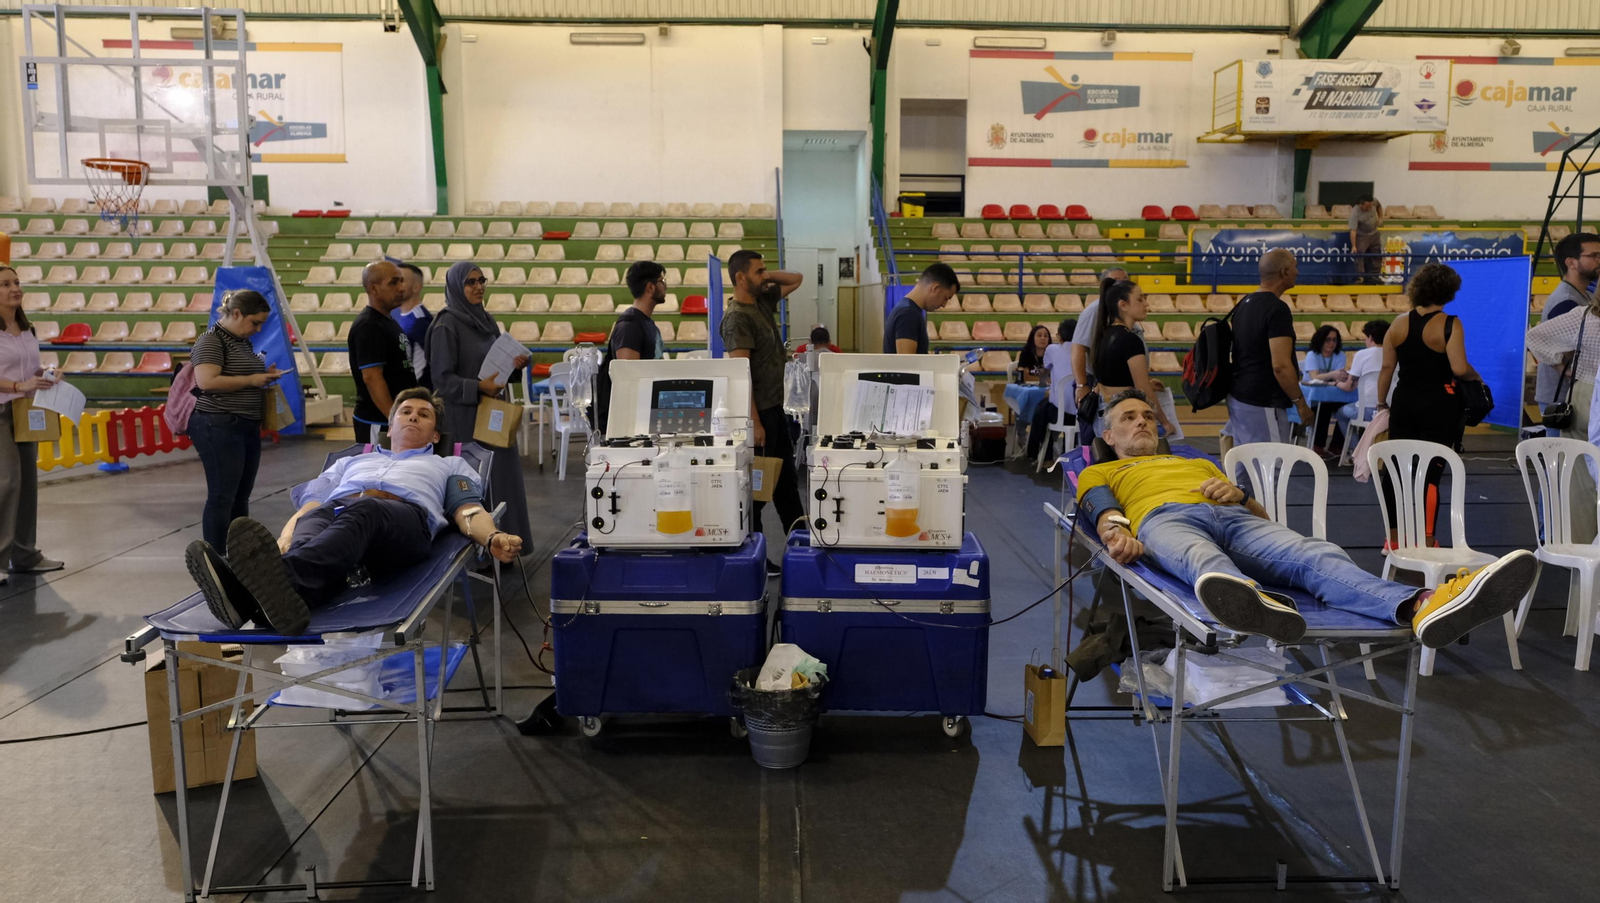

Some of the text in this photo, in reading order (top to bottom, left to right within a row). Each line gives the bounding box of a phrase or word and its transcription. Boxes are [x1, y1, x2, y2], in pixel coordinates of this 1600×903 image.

[1313, 74, 1377, 86] FASE ASCENSO
[256, 92, 285, 101] RURAL
[1323, 91, 1383, 107] NACIONAL
[1480, 79, 1577, 108] cajamar
[1102, 127, 1173, 148] cajamar
